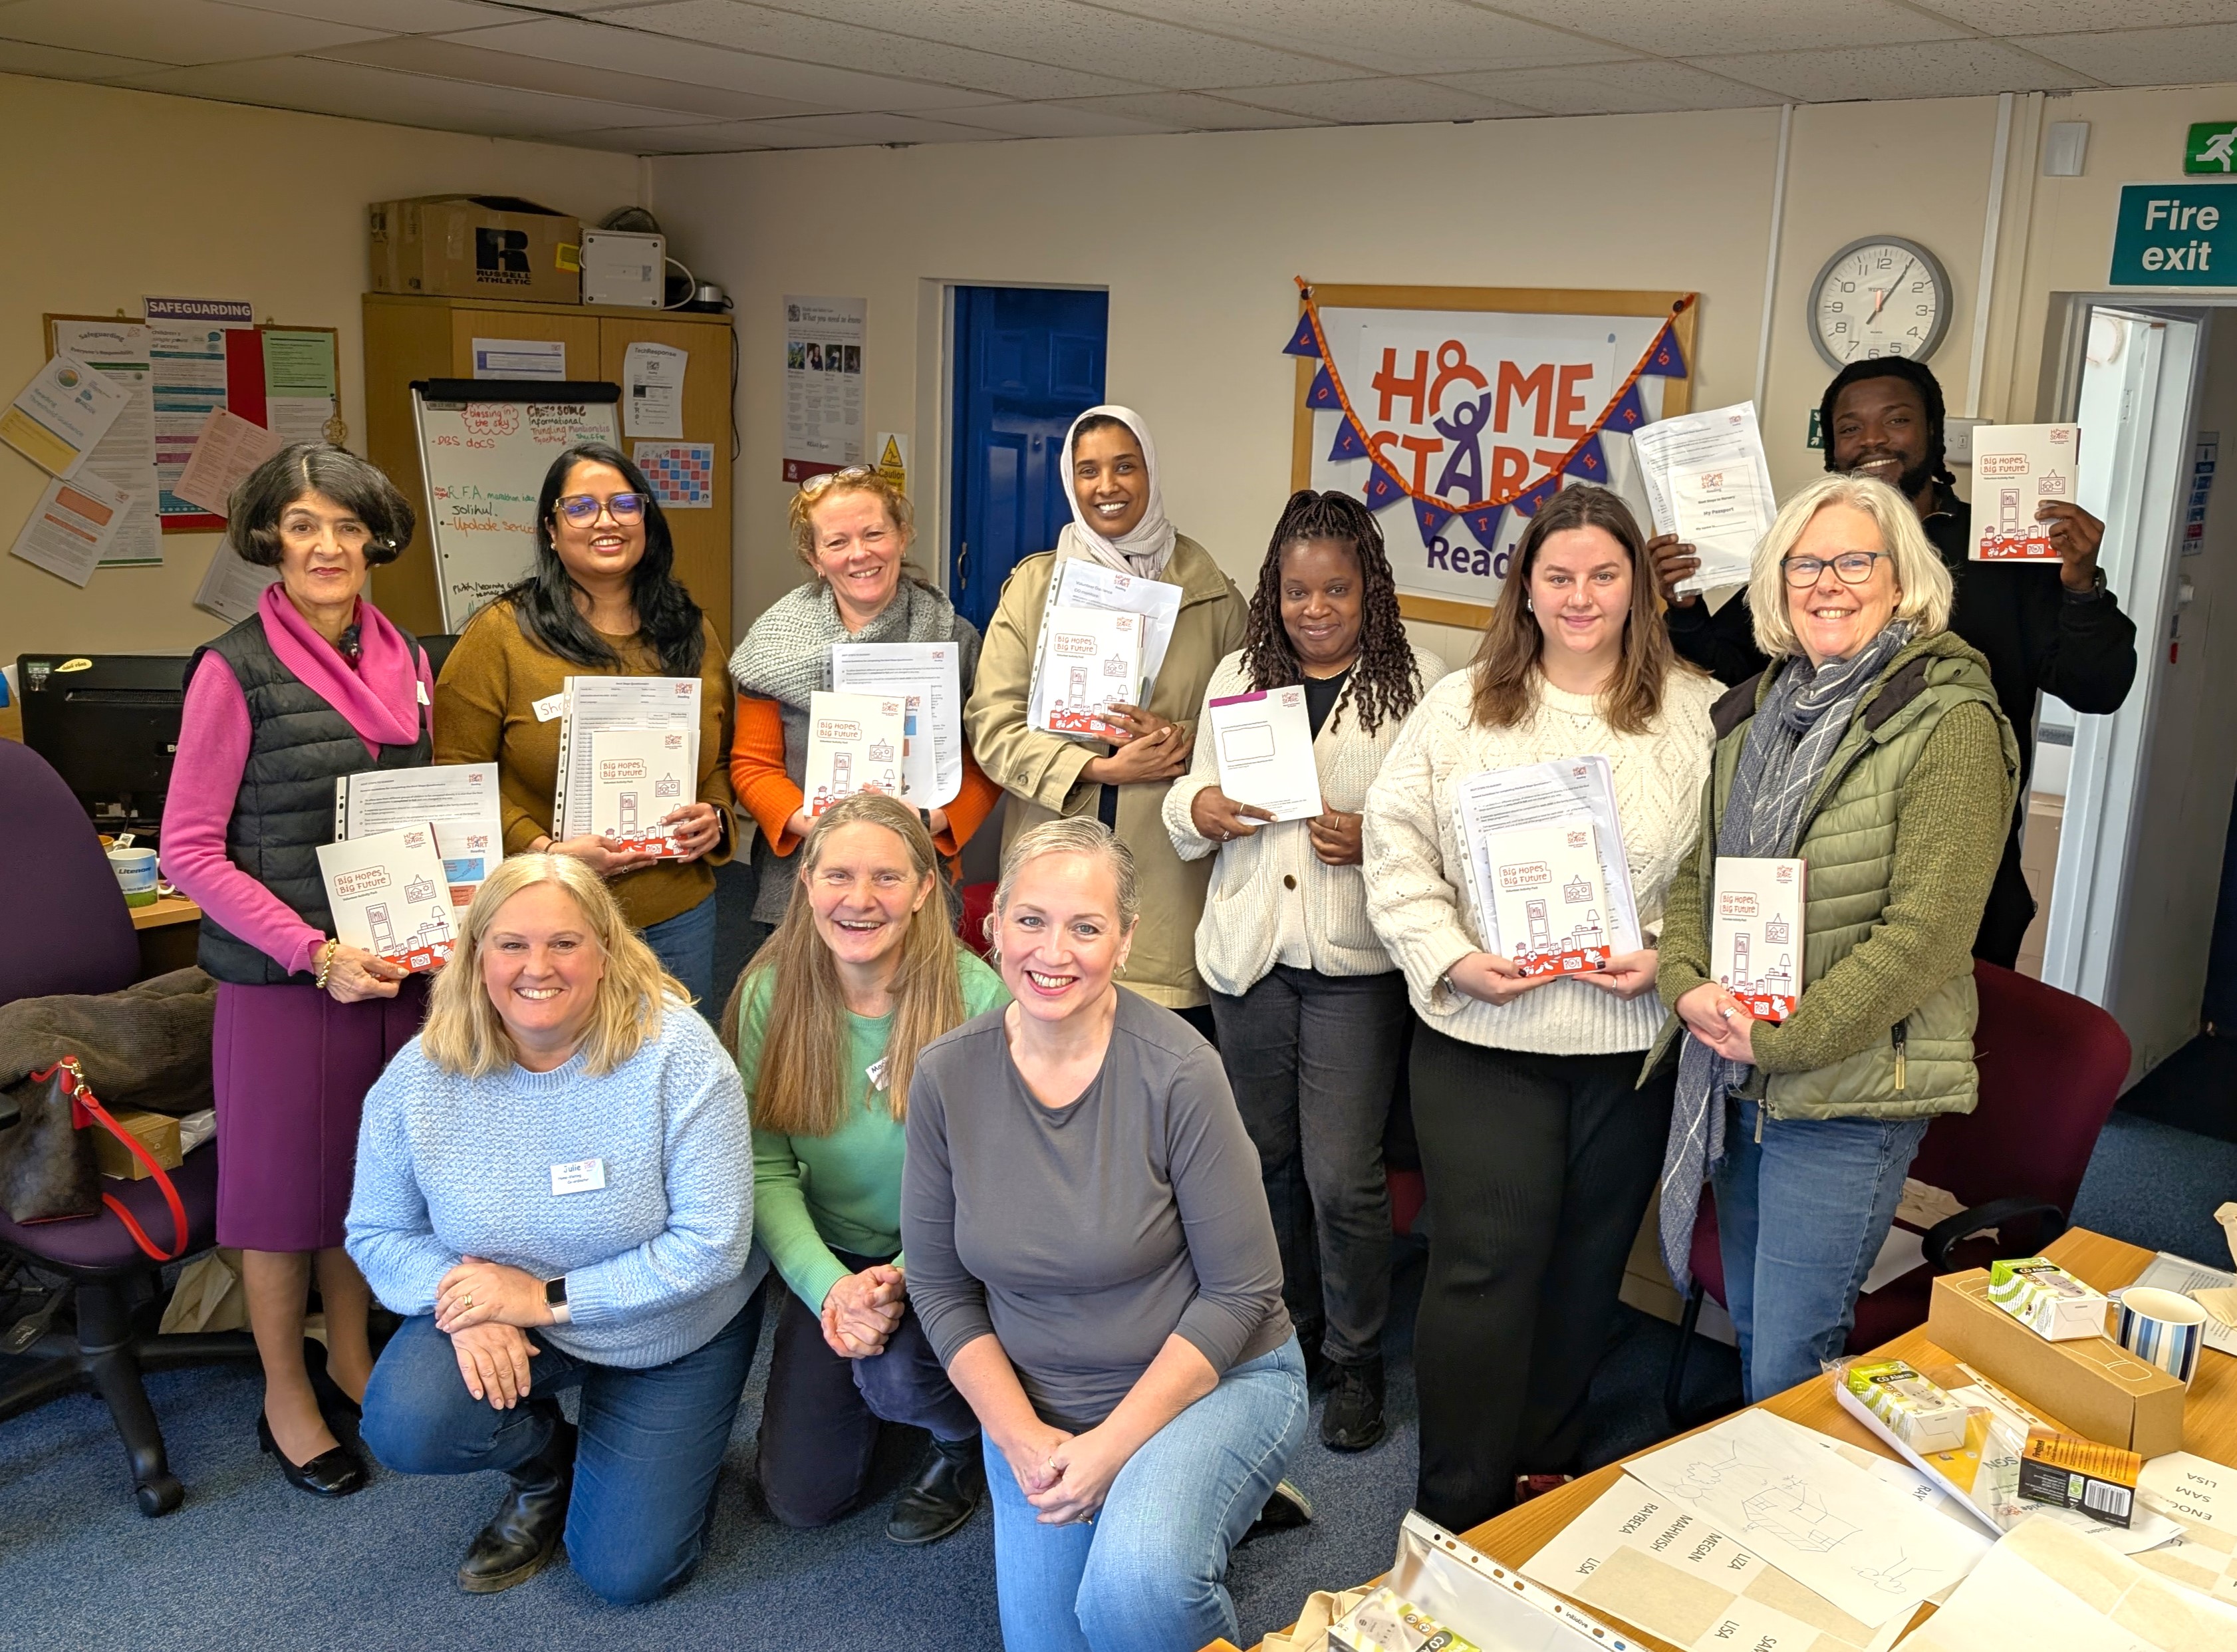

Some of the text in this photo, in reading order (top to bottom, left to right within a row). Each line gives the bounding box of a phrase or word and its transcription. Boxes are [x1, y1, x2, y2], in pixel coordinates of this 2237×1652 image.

[2145, 200, 2219, 231] Fire
[2142, 241, 2212, 272] exit
[1877, 258, 1893, 270] 12
[476, 269, 531, 279] RUSSELL
[1859, 265, 1868, 276] 11
[476, 277, 531, 285] ATHLETIC
[1911, 281, 1924, 293] 2
[1841, 282, 1856, 293] 10
[149, 301, 251, 316] SAFEGUARDING
[1832, 302, 1843, 313] 9
[1915, 305, 1928, 317] 3
[1835, 322, 1847, 334] 8
[1907, 327, 1918, 338] 4
[78, 331, 126, 343] Safeguarding
[634, 347, 677, 357] TechResponse
[1848, 341, 1860, 352] 7
[1889, 343, 1902, 354] 5
[1868, 348, 1880, 360] 6
[1371, 339, 1594, 440] HOME
[475, 418, 510, 430] the sky
[878, 468, 905, 480] Caution
[1700, 472, 1724, 482] HOME
[1700, 478, 1724, 489] START
[466, 835, 488, 843] HOME
[563, 1164, 581, 1173] Julie
[1891, 1373, 1913, 1381] Alarm
[1982, 1456, 2019, 1470] SGN
[2186, 1472, 2218, 1488] LISA
[2174, 1485, 2212, 1503] SAM
[1618, 1502, 1659, 1534] RAYBEKA
[1649, 1514, 1694, 1552] MAHWISH
[1687, 1532, 1723, 1563] MEGAN
[1575, 1557, 1601, 1576] LISA
[1726, 1553, 1752, 1570] LIZA
[1714, 1619, 1740, 1639] LISA
[1429, 1635, 1445, 1649] CO
